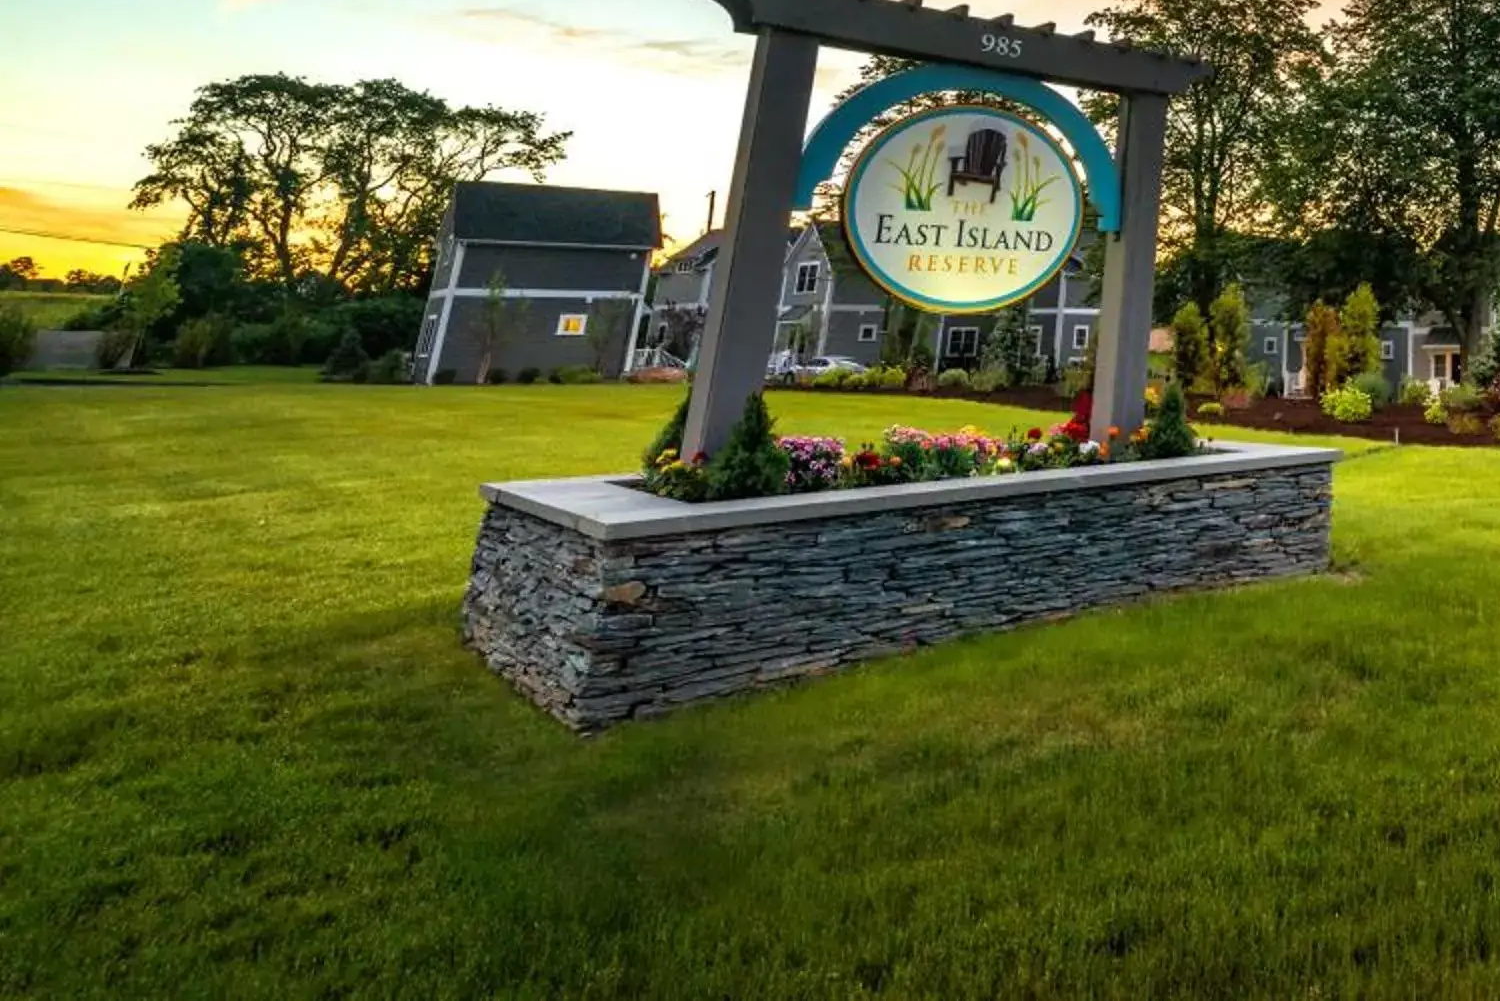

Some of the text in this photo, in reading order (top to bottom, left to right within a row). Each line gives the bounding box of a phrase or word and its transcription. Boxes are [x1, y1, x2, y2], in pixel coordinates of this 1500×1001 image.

[980, 34, 1022, 58] 985
[952, 200, 988, 216] THE
[875, 213, 1053, 251] EAST ISLAND
[908, 255, 1019, 274] RESERVE
